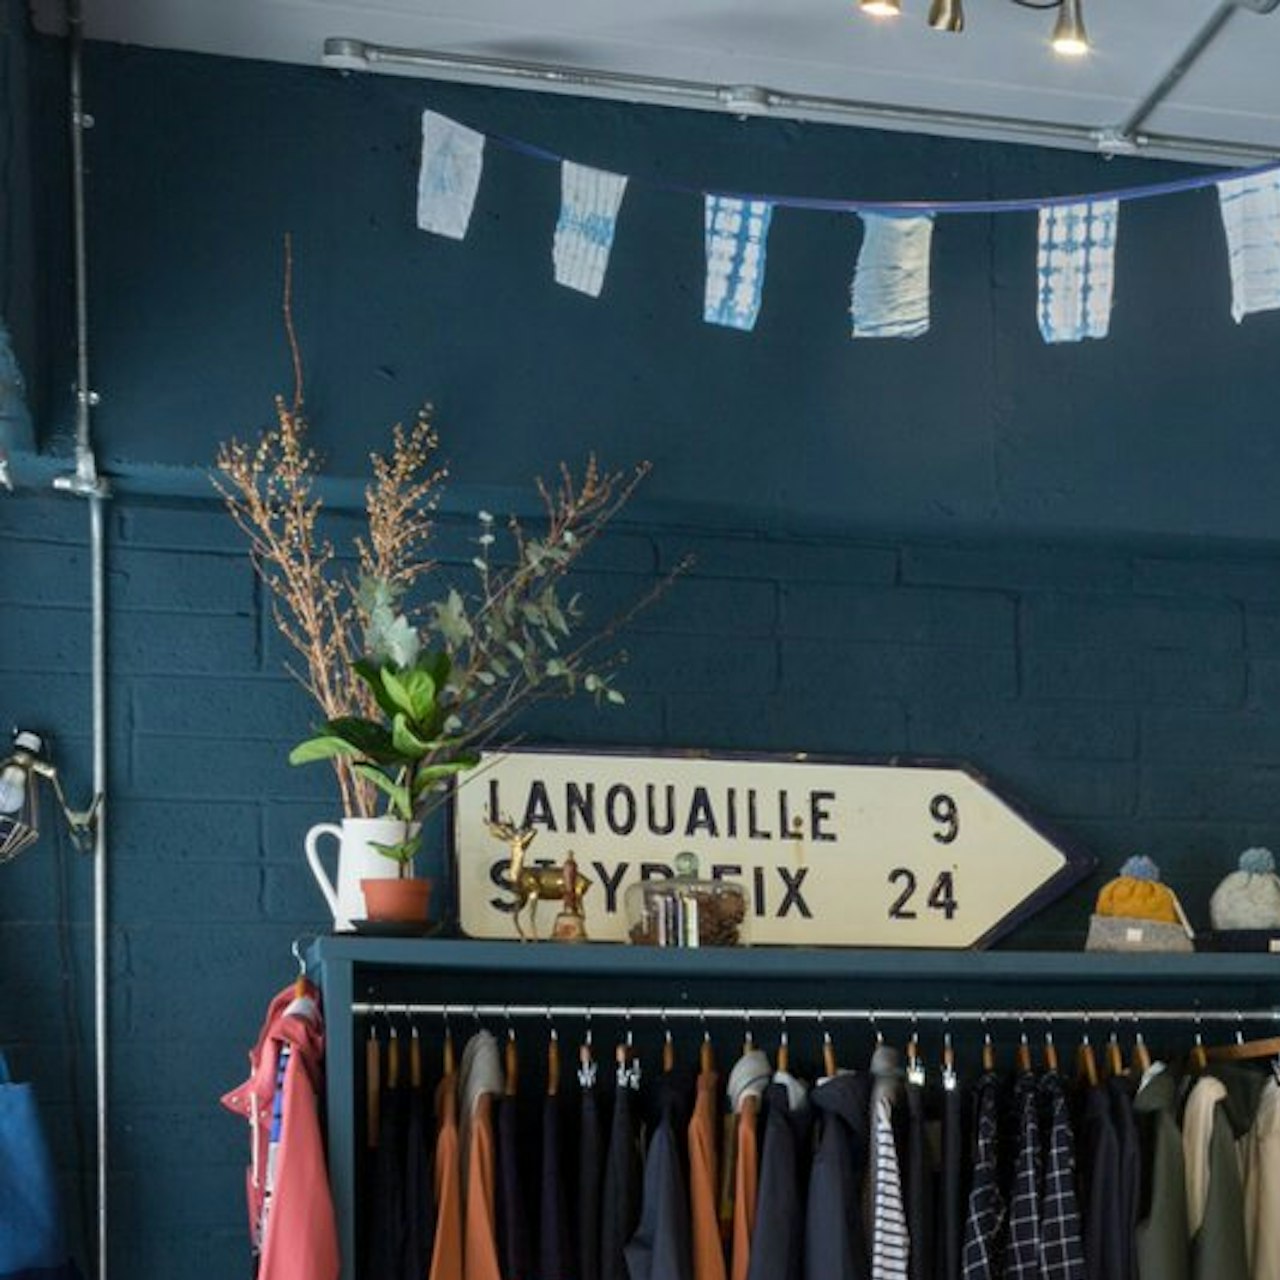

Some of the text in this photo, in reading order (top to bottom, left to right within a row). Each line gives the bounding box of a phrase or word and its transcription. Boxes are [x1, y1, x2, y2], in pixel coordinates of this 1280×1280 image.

[489, 779, 959, 844] LANOUAILLE 9
[887, 869, 958, 920] 24
